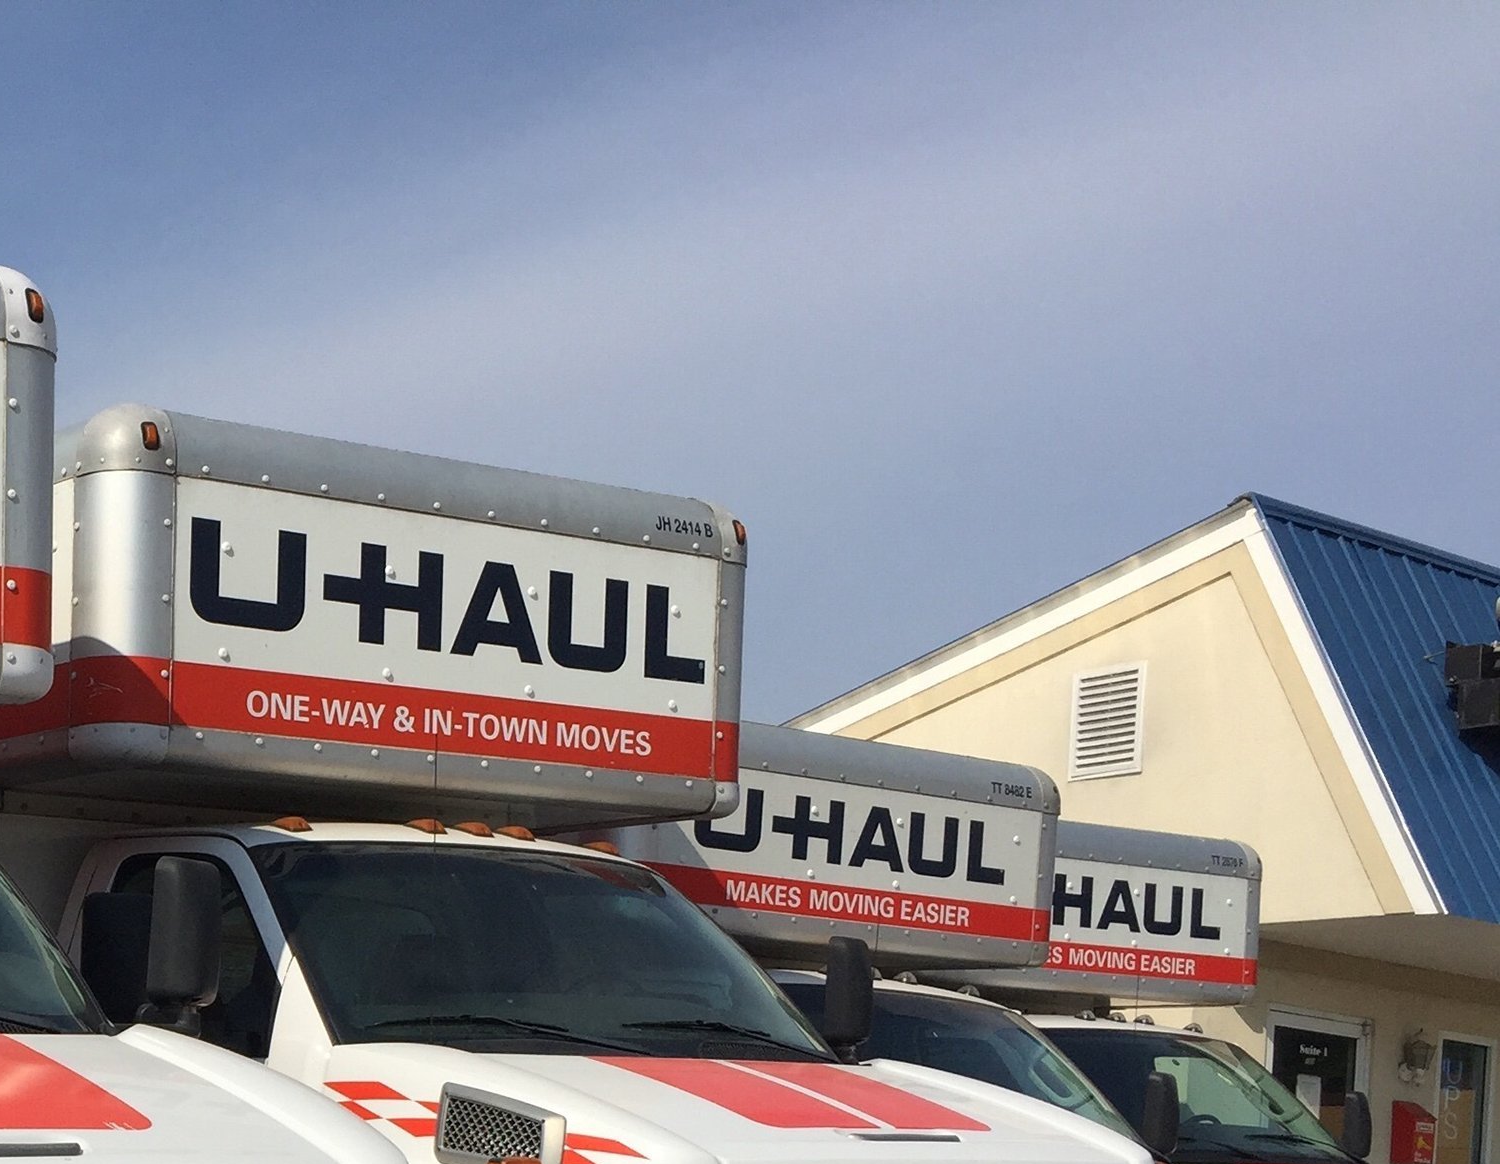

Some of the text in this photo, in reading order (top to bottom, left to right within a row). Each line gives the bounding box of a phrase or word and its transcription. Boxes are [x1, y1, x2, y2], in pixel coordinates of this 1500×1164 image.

[655, 515, 714, 538] JH 2414 B
[188, 516, 706, 686] U-HAUL
[246, 689, 652, 757] ONE-WAY & IN-TOWN MOVES
[991, 781, 1002, 794] TT
[725, 878, 970, 928] MAKES MOVING EASIER
[1068, 947, 1136, 971] MOVING
[1140, 954, 1196, 977] EASIER
